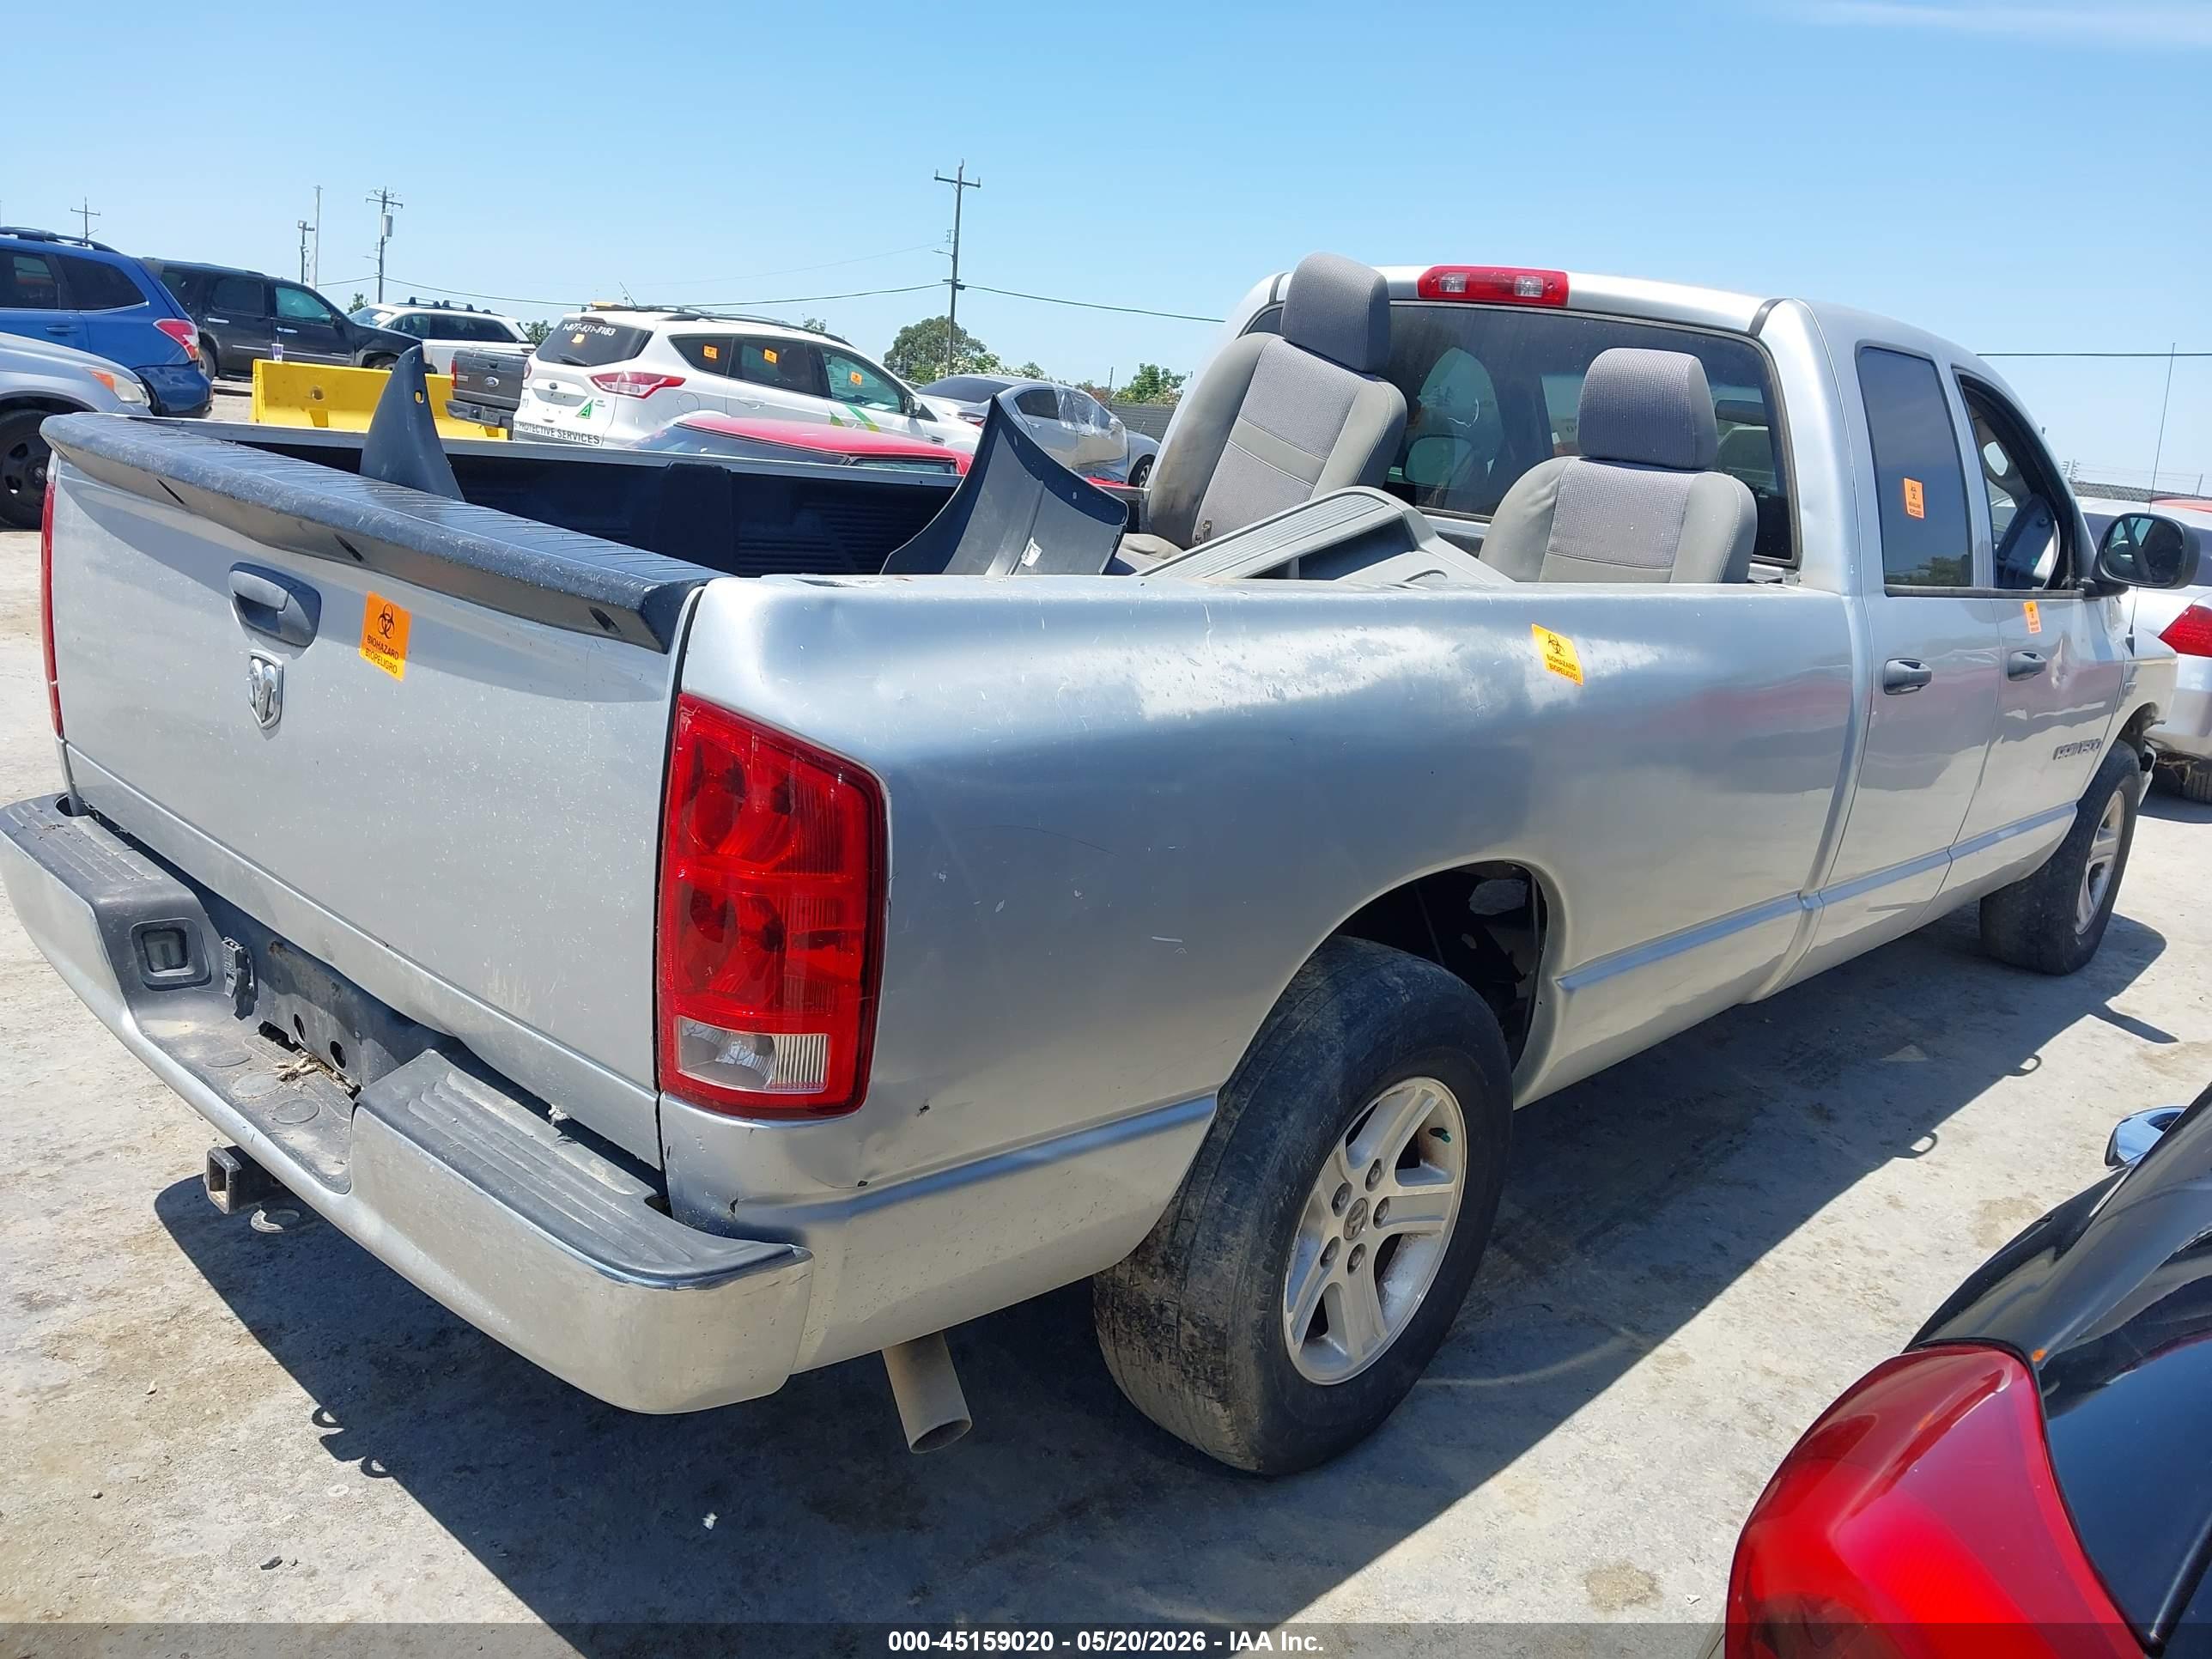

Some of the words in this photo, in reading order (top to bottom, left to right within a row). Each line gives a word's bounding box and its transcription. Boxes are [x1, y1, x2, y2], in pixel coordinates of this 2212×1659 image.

[519, 422, 556, 438] PROTECTIVE
[557, 428, 600, 445] SERVICES
[367, 635, 399, 660] BIOHAZARD
[365, 647, 398, 674] BIOPELIGRO
